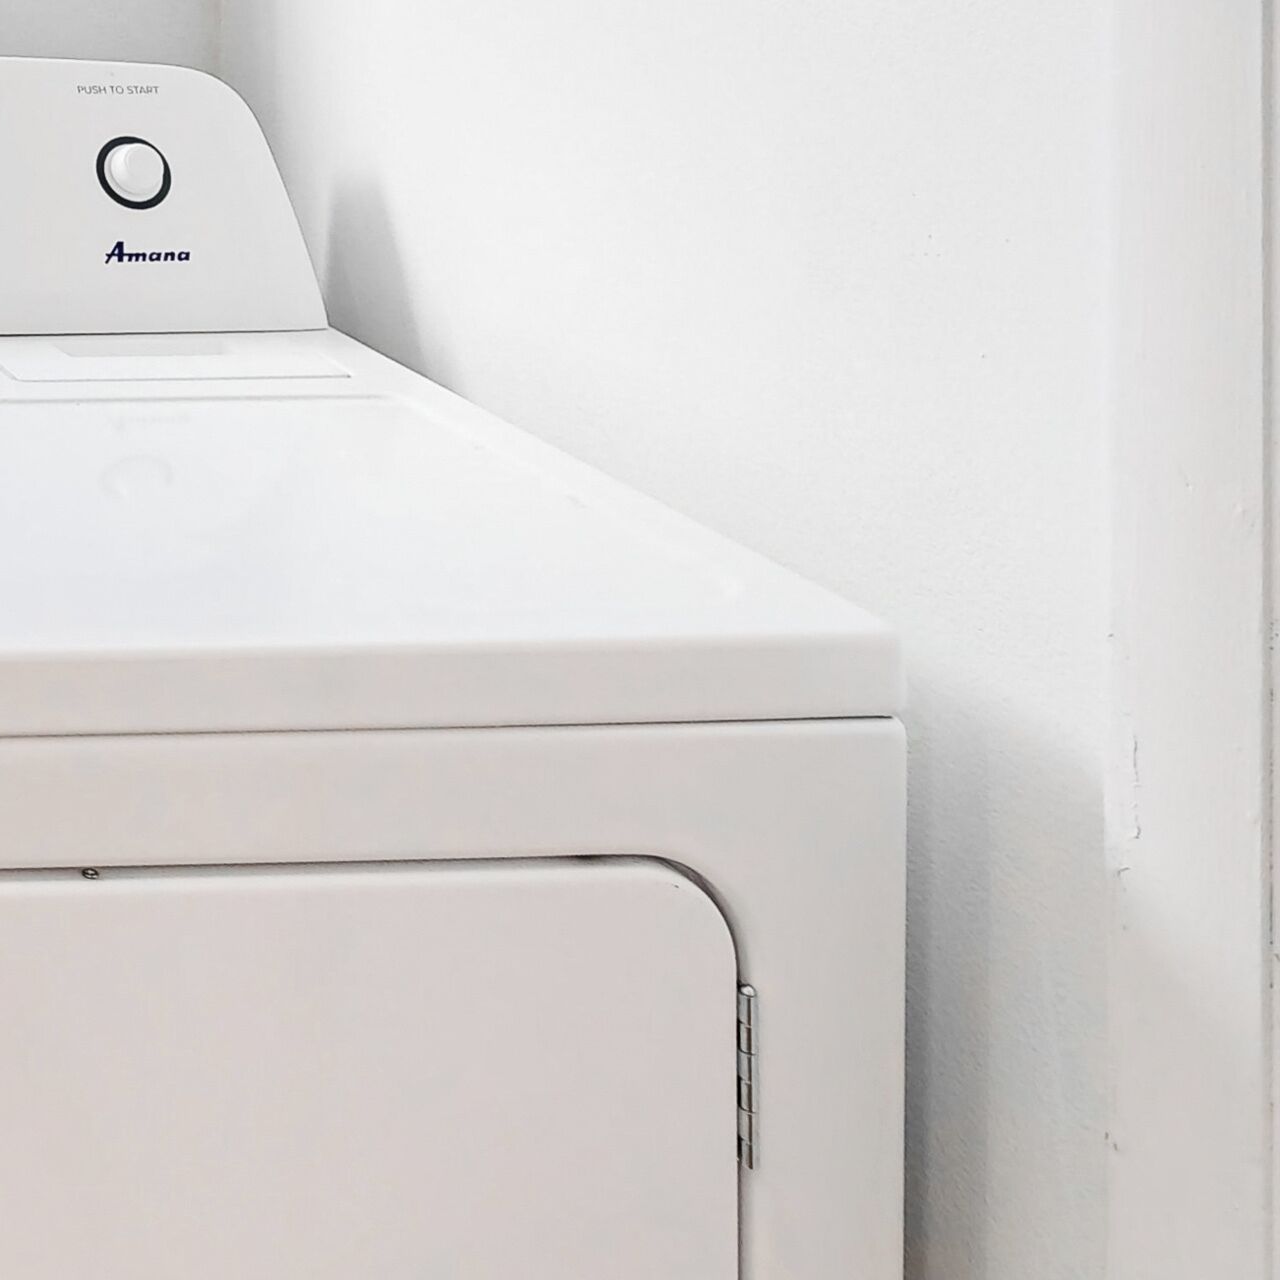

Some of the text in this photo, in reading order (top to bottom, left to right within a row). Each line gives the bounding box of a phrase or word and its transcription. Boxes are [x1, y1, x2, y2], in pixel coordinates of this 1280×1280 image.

[76, 85, 160, 95] PUSH TO START
[105, 241, 191, 264] Amana
